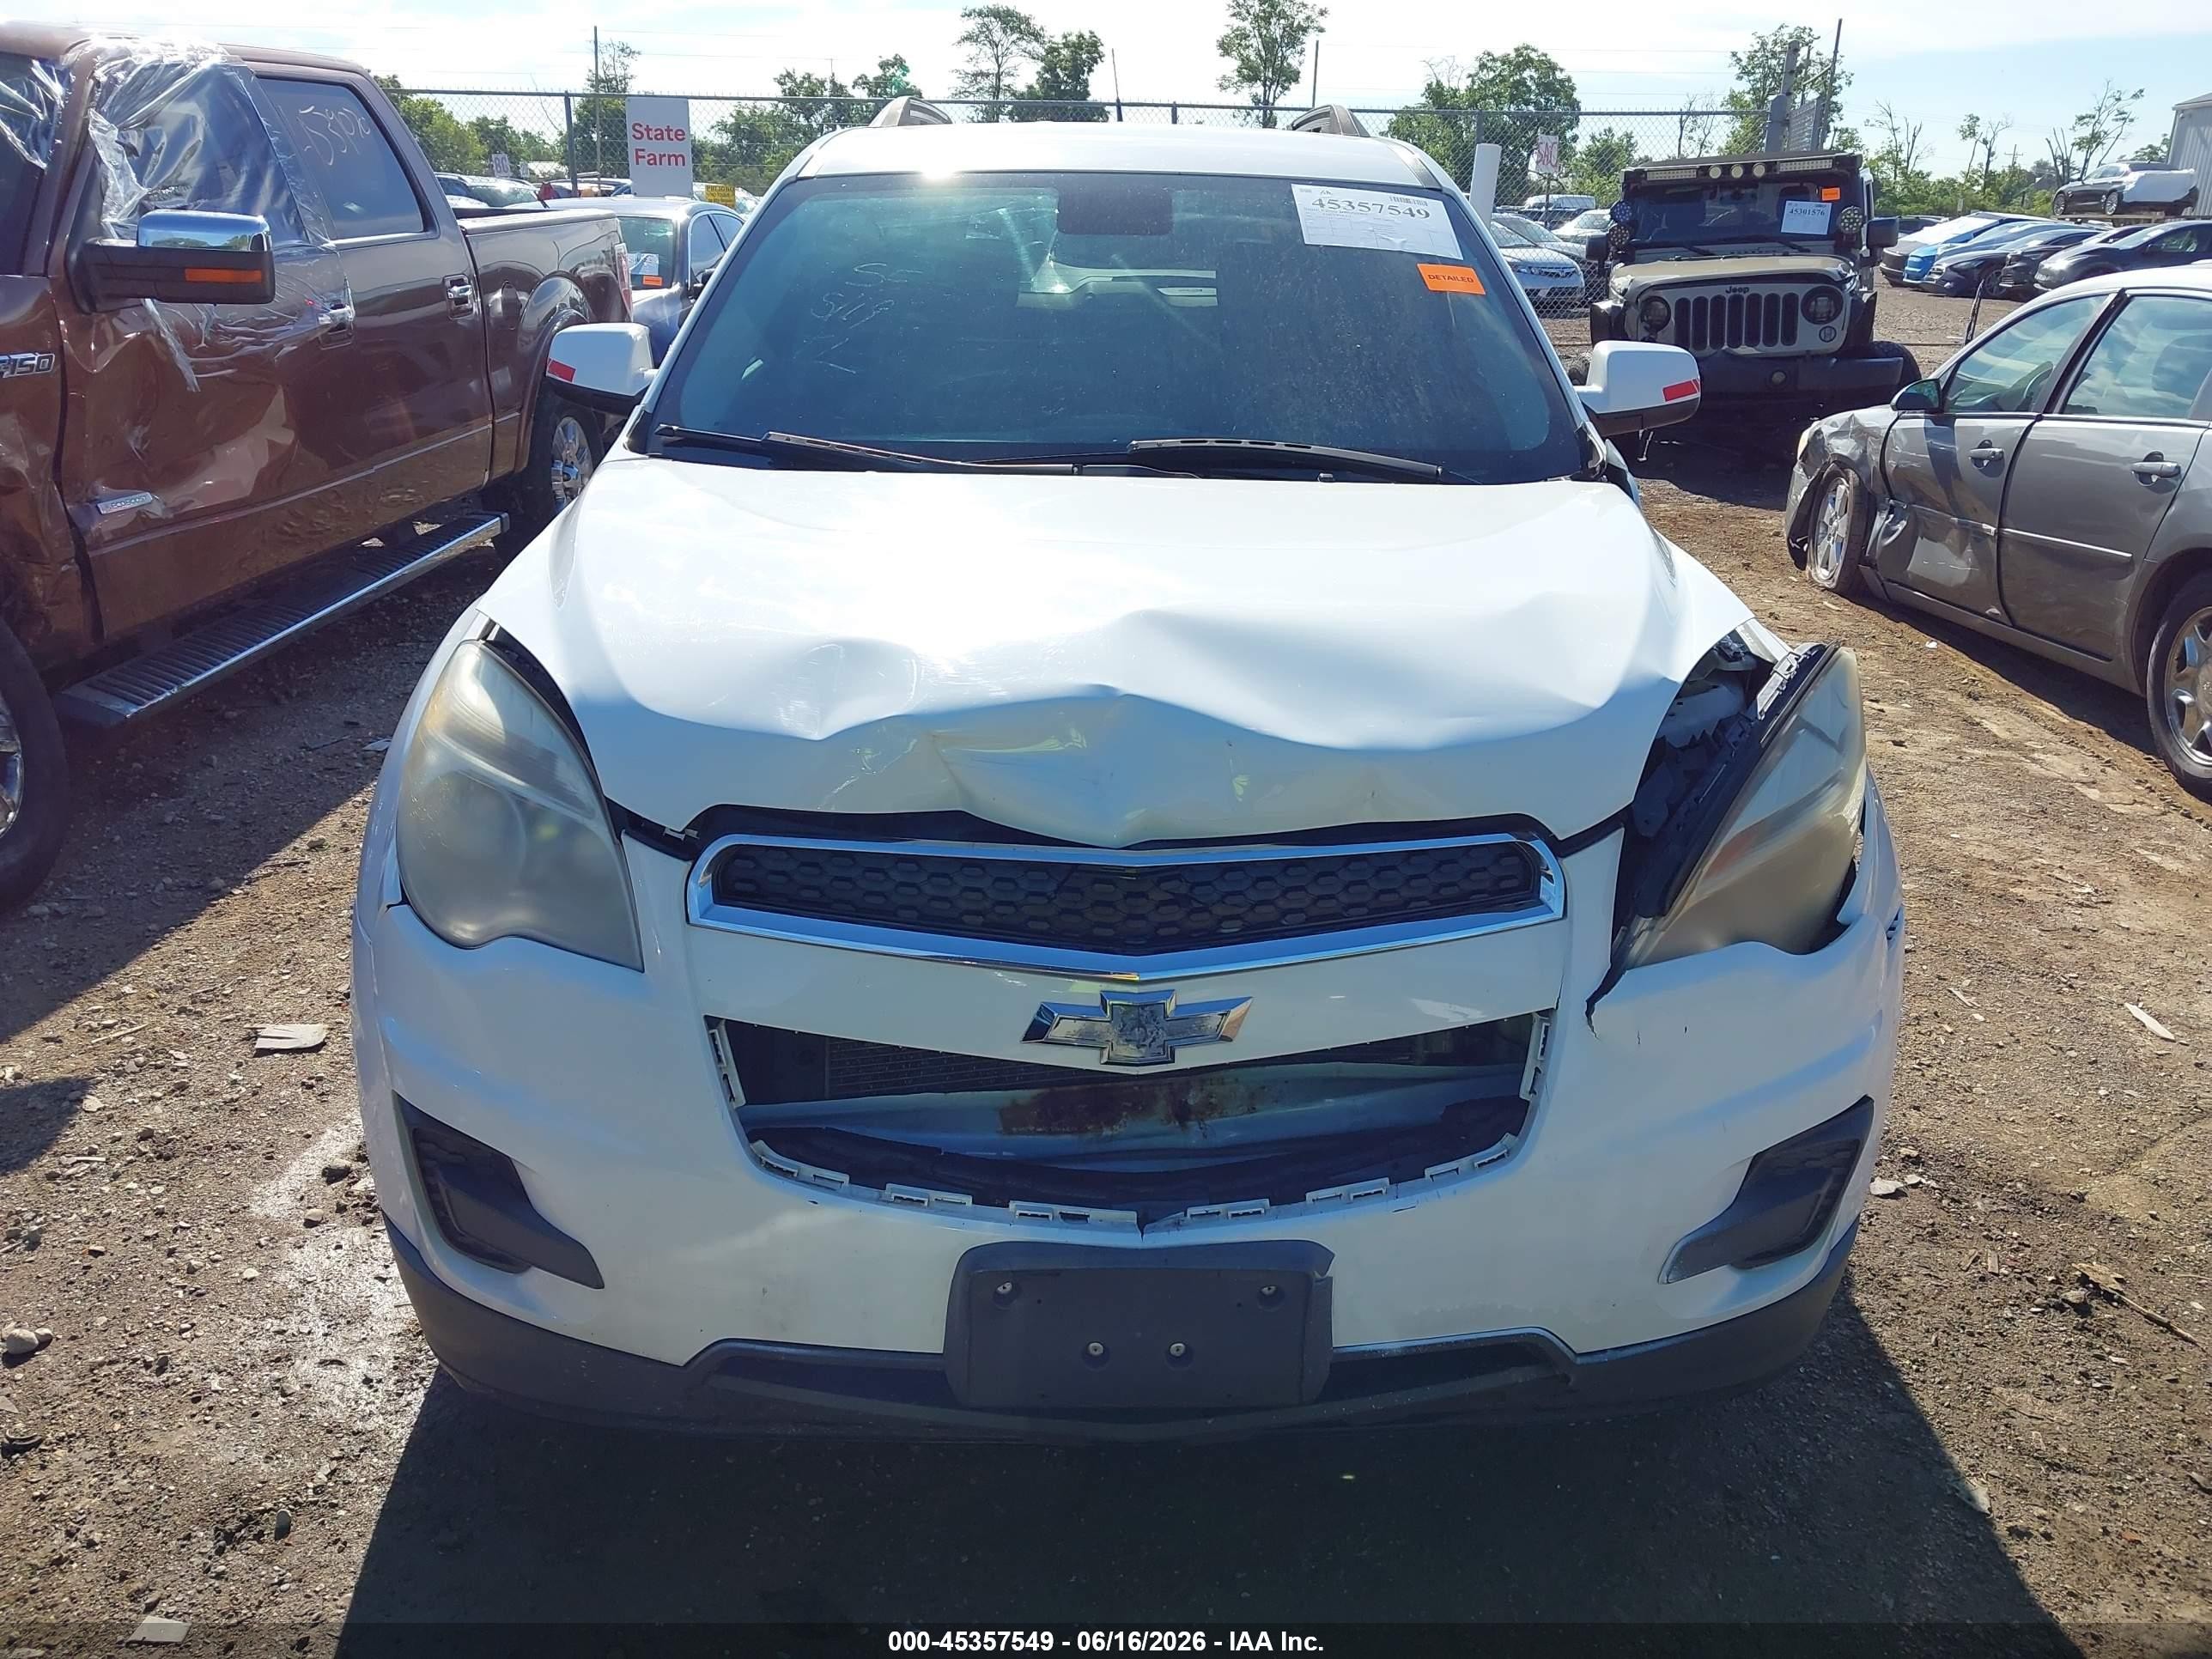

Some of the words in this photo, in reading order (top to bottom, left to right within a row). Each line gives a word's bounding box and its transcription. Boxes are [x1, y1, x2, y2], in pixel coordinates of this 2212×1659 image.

[631, 122, 686, 142] State
[634, 148, 686, 167] Farm
[1311, 198, 1431, 219] 45357549
[1428, 274, 1474, 283] DETAILED
[1725, 285, 1750, 294] Jeep
